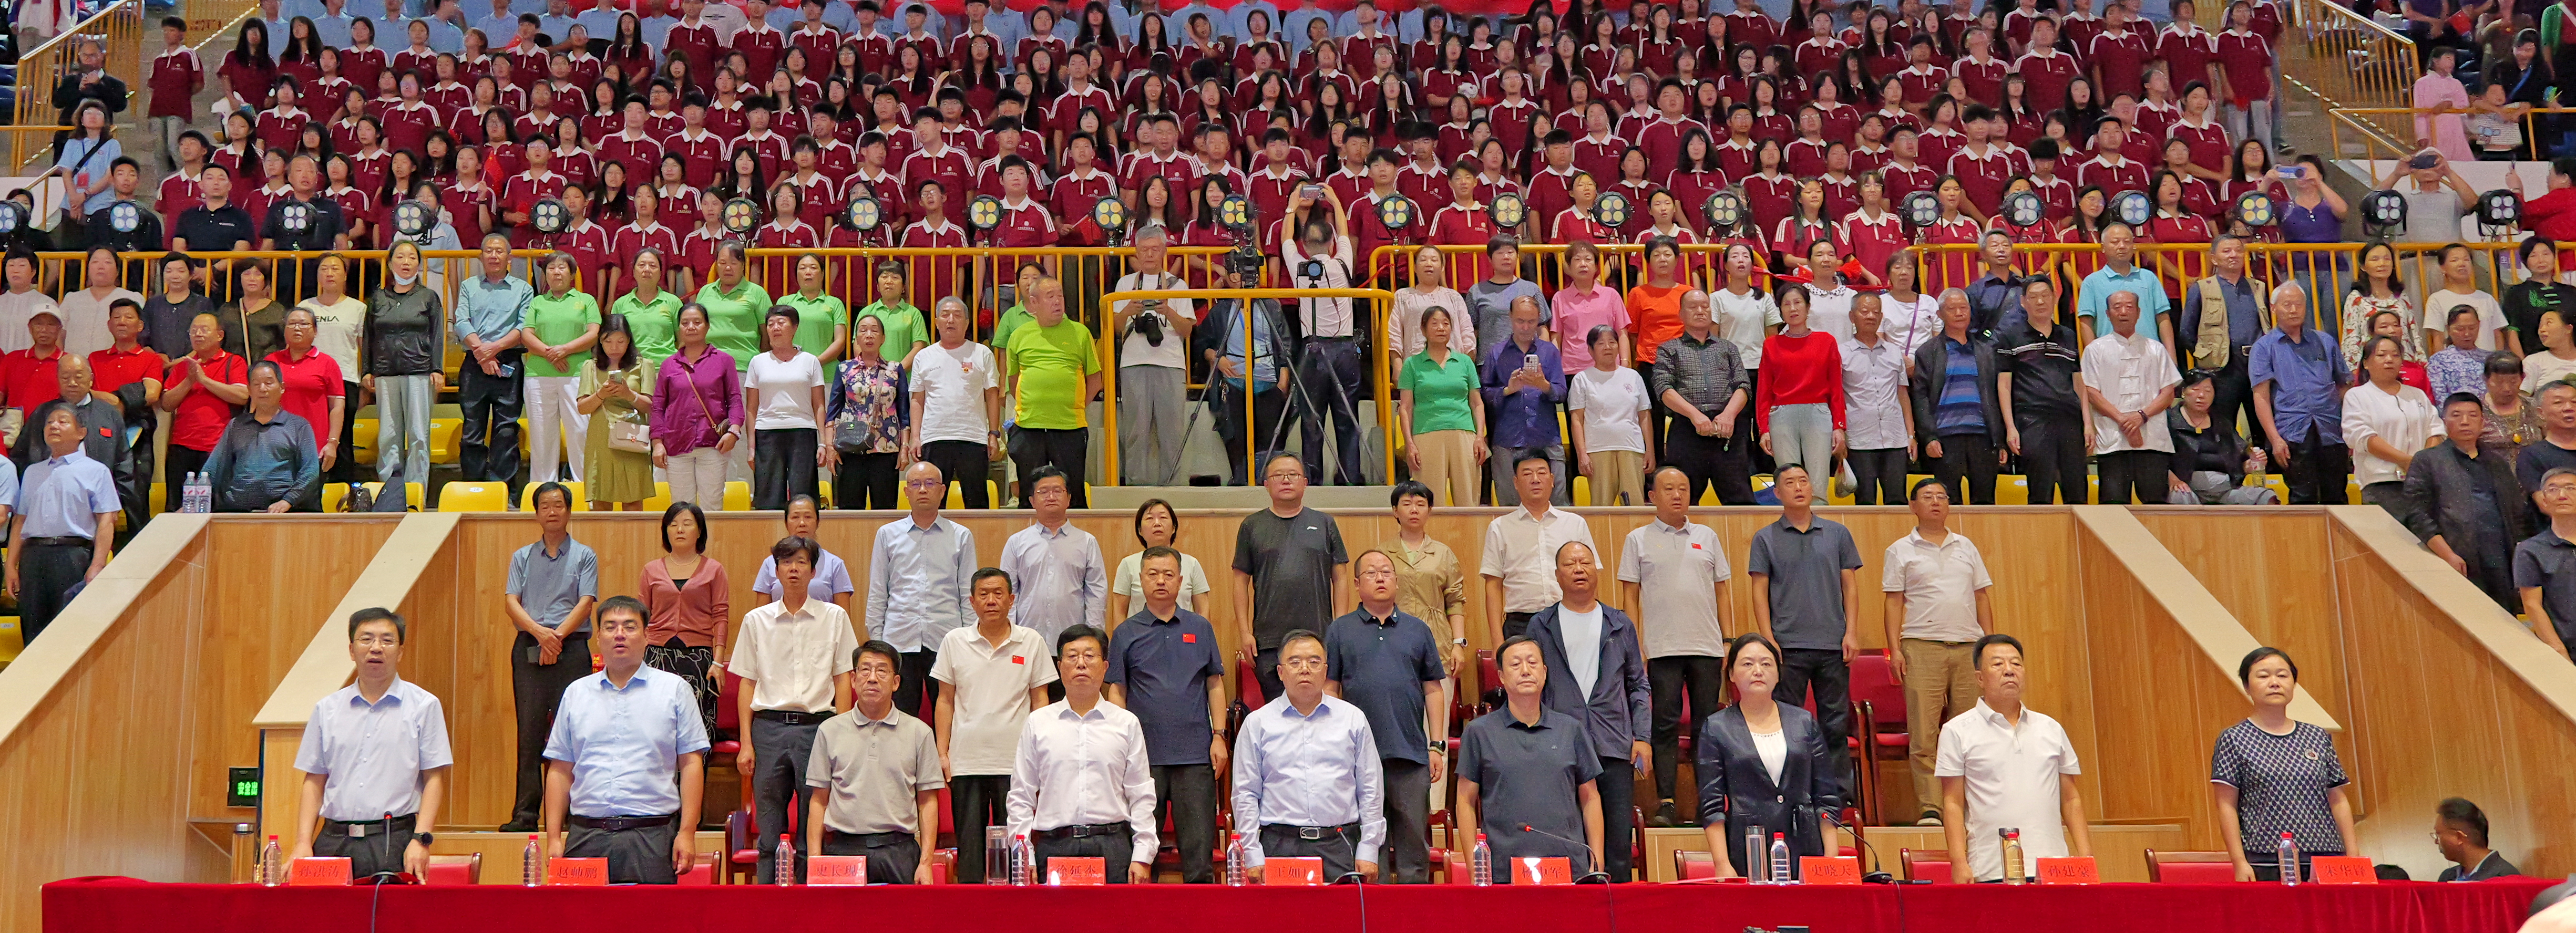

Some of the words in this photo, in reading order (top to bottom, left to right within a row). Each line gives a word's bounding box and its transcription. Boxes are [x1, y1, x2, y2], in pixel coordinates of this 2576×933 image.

[557, 866, 598, 879] 赵帅鹏
[1811, 864, 1852, 877] 史晓天
